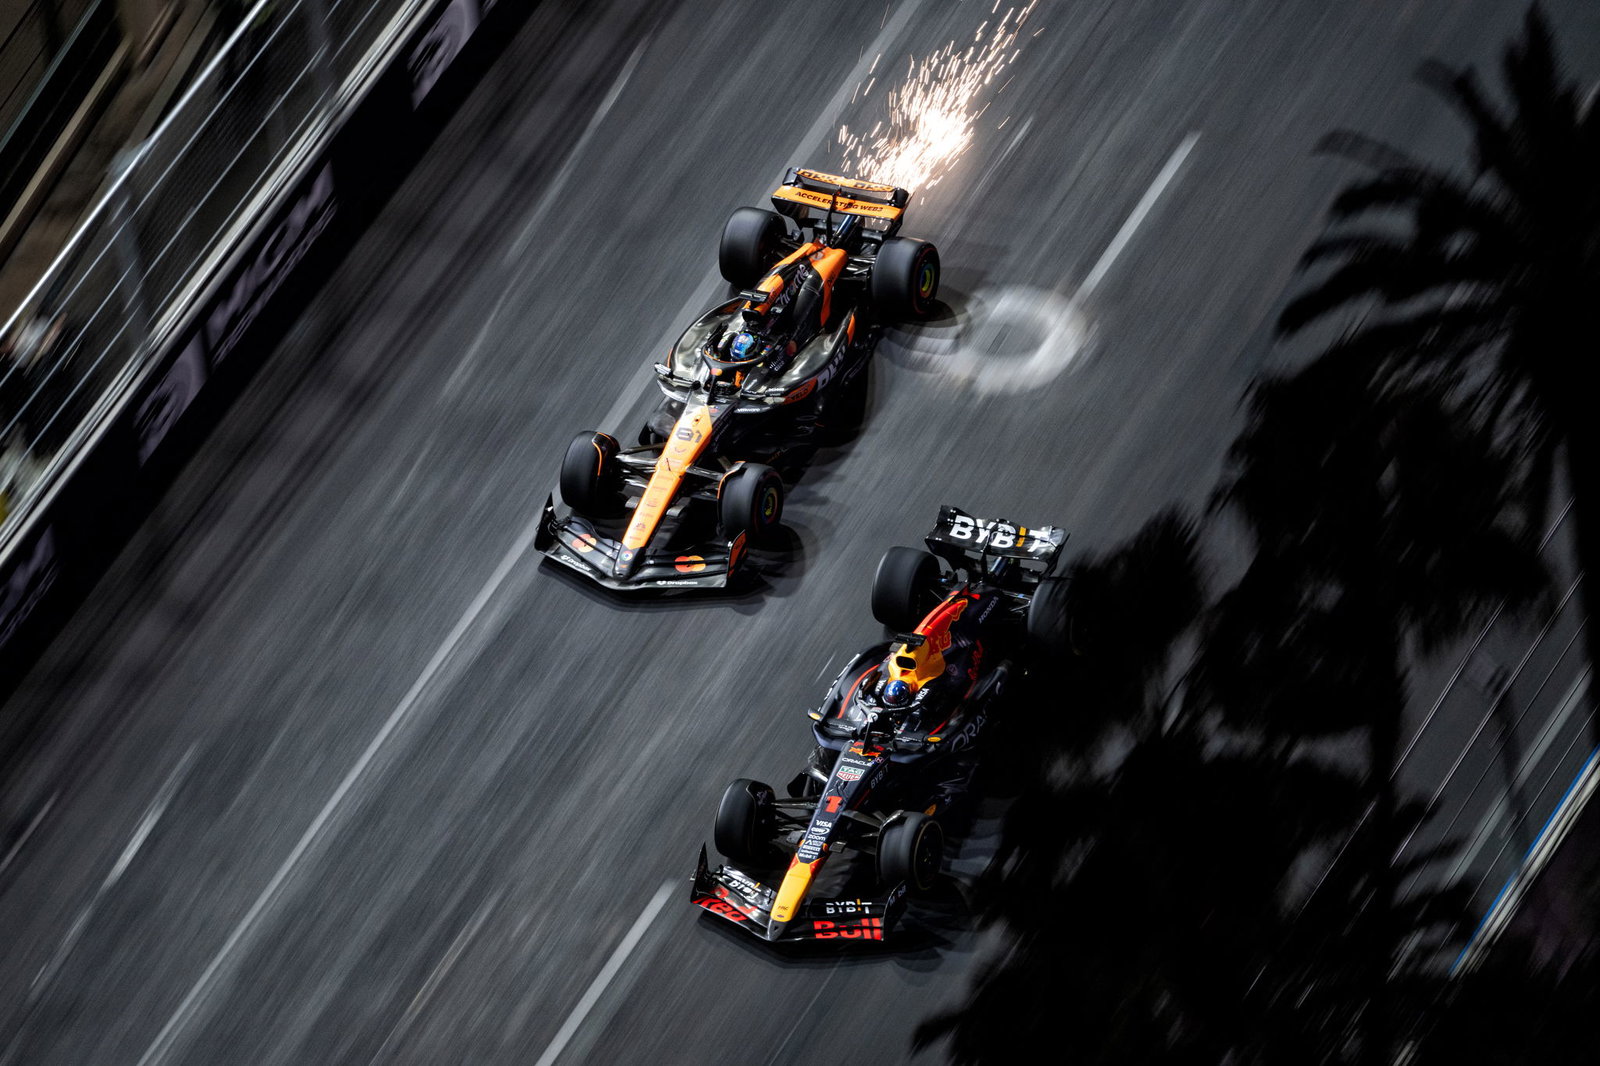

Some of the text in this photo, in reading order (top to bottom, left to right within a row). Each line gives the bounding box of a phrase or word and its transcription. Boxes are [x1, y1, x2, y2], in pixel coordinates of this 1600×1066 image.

[949, 515, 1050, 553] BYBIT
[842, 757, 873, 767] ORACLE
[816, 819, 832, 828] VISA
[826, 898, 872, 914] BYBIT
